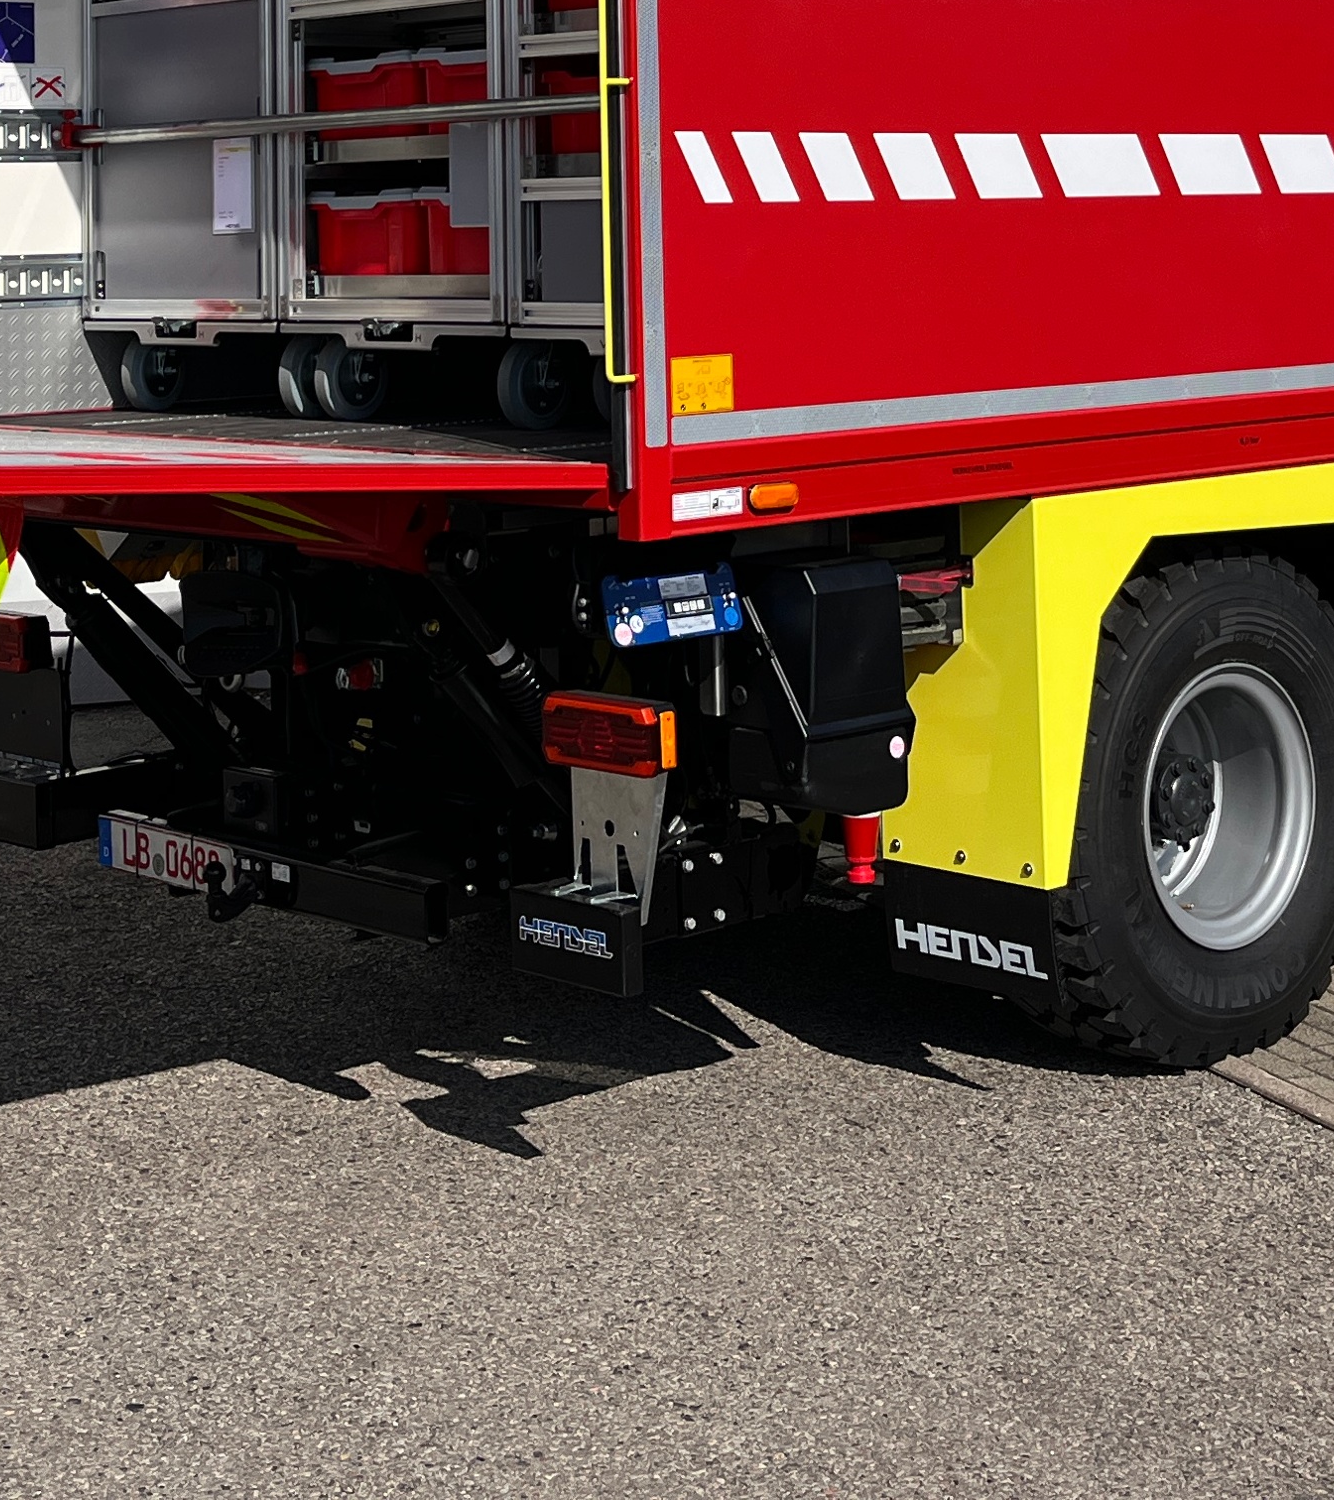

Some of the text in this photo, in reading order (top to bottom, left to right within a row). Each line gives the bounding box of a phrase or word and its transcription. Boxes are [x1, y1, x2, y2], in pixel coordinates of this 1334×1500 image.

[122, 828, 150, 870] LB
[518, 916, 613, 959] HENSEL
[894, 918, 1049, 980] HENSEL
